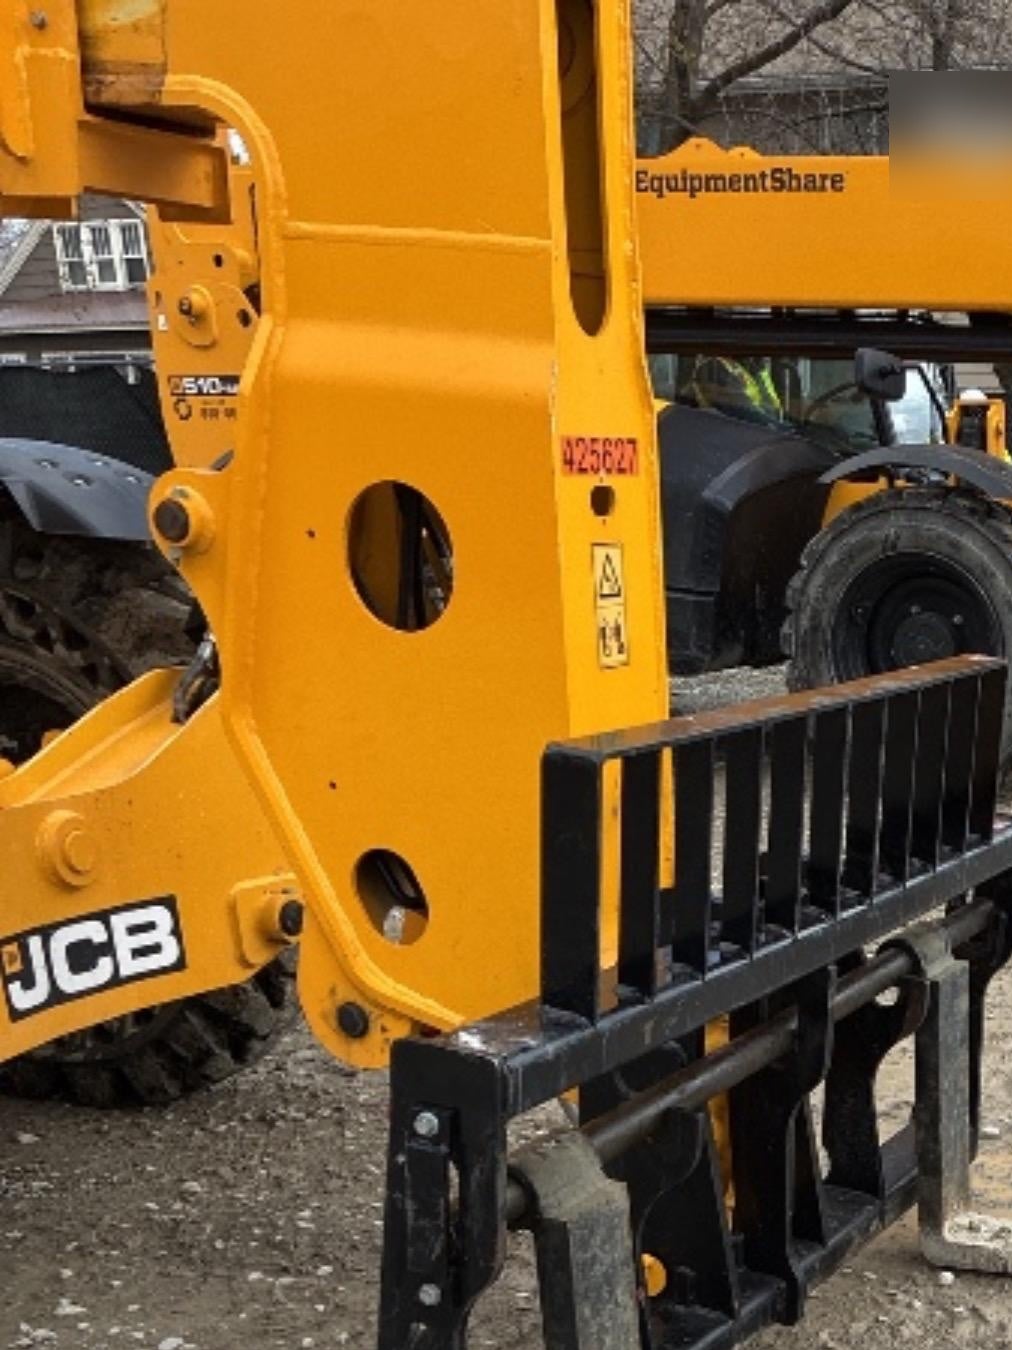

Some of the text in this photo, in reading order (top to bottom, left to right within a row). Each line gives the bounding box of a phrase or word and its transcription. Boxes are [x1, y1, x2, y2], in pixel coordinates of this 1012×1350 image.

[635, 168, 844, 199] EquipmentShare
[563, 438, 636, 474] 425627
[8, 905, 181, 1011] JCB
